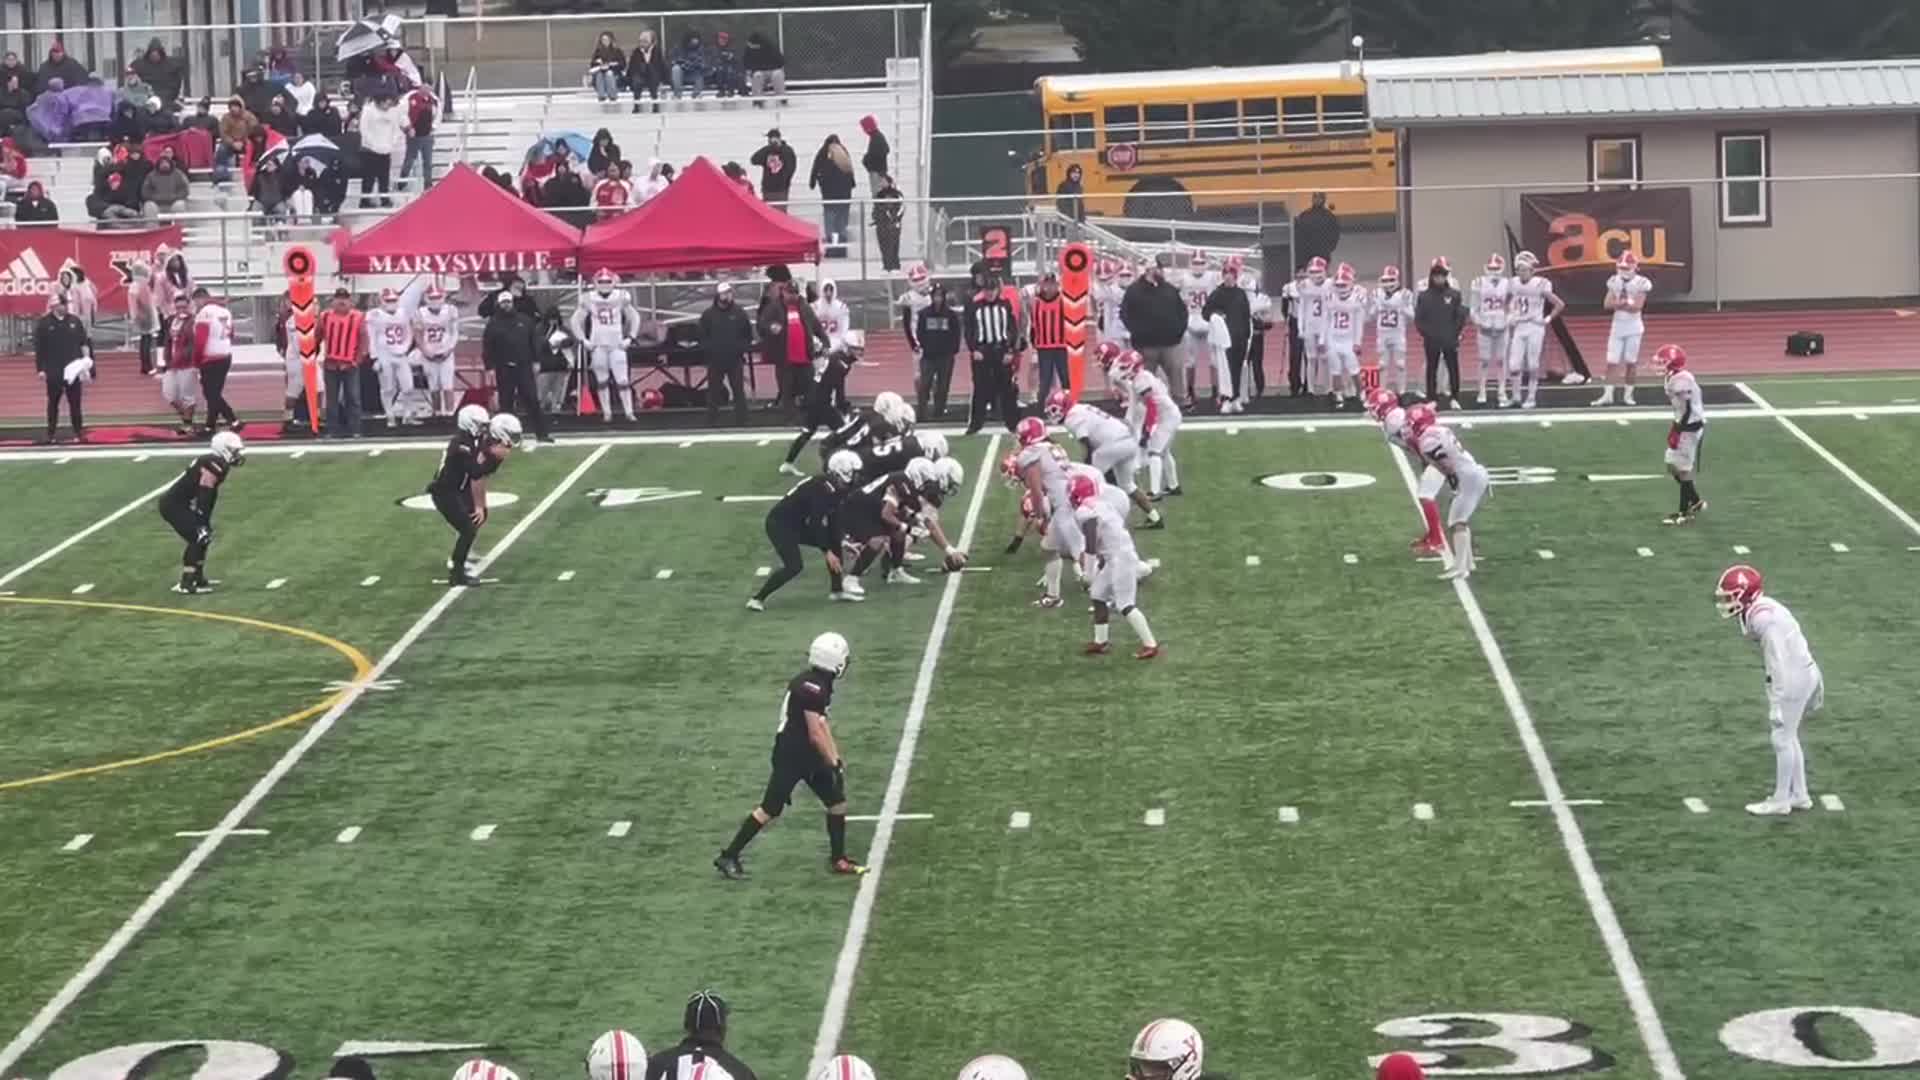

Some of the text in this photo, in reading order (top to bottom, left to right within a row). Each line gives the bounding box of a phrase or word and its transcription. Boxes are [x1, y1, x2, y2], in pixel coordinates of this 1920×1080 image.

[984, 229, 1008, 259] 2
[1547, 213, 1667, 266] acu
[368, 251, 552, 273] MARYSVILLE
[1312, 299, 1323, 318] 3
[1333, 311, 1350, 329] 12
[384, 323, 405, 345] 59
[1368, 1006, 1920, 1077] 3 0
